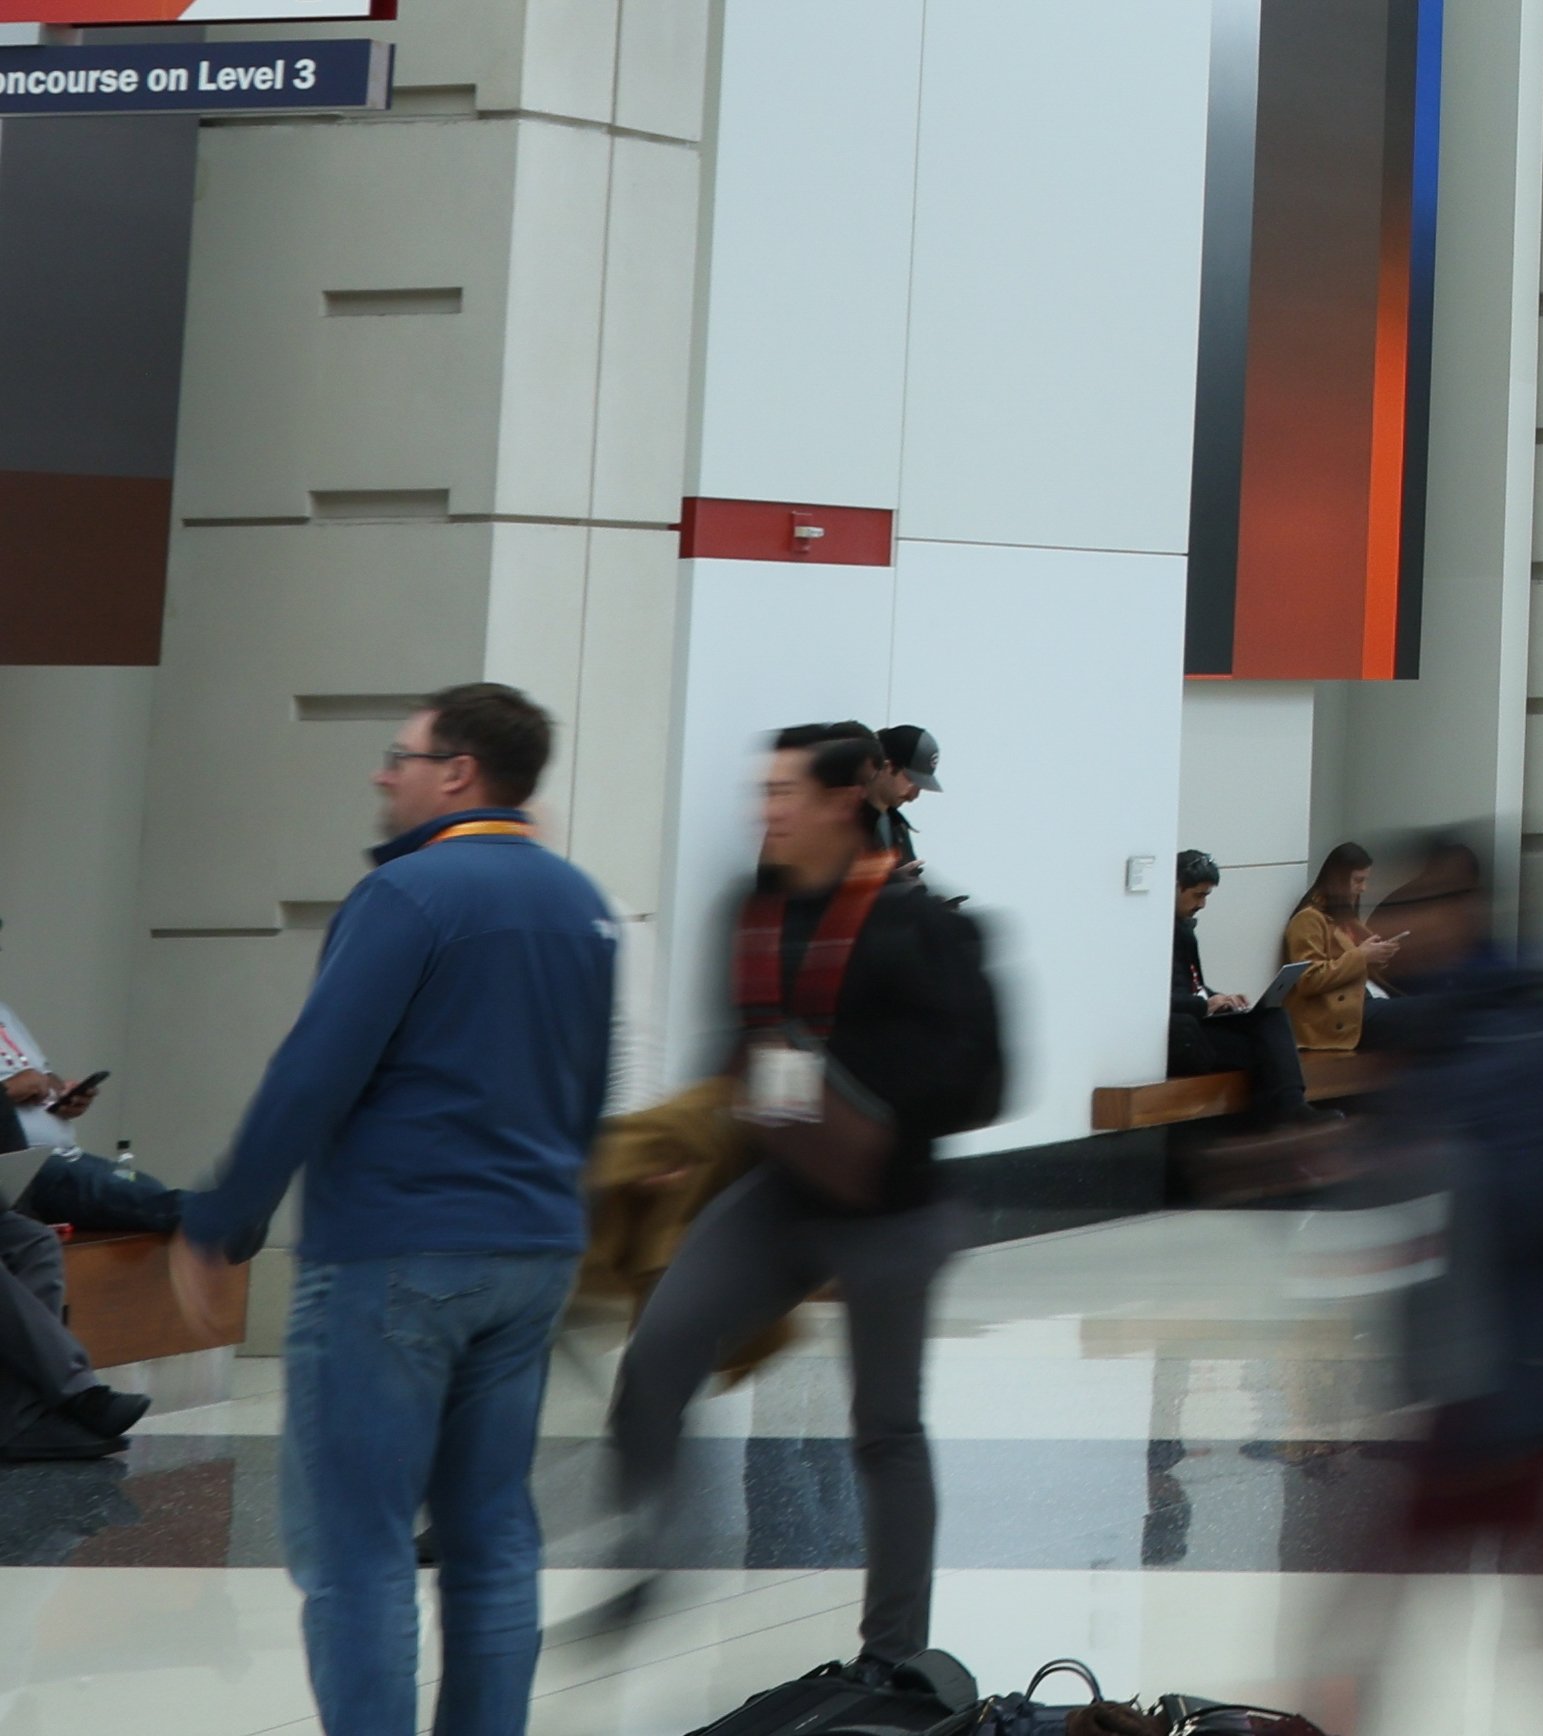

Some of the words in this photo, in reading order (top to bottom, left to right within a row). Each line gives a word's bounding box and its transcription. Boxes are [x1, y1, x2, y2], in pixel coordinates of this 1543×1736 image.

[146, 66, 188, 93] on
[198, 59, 285, 92] Level
[293, 59, 317, 90] 3
